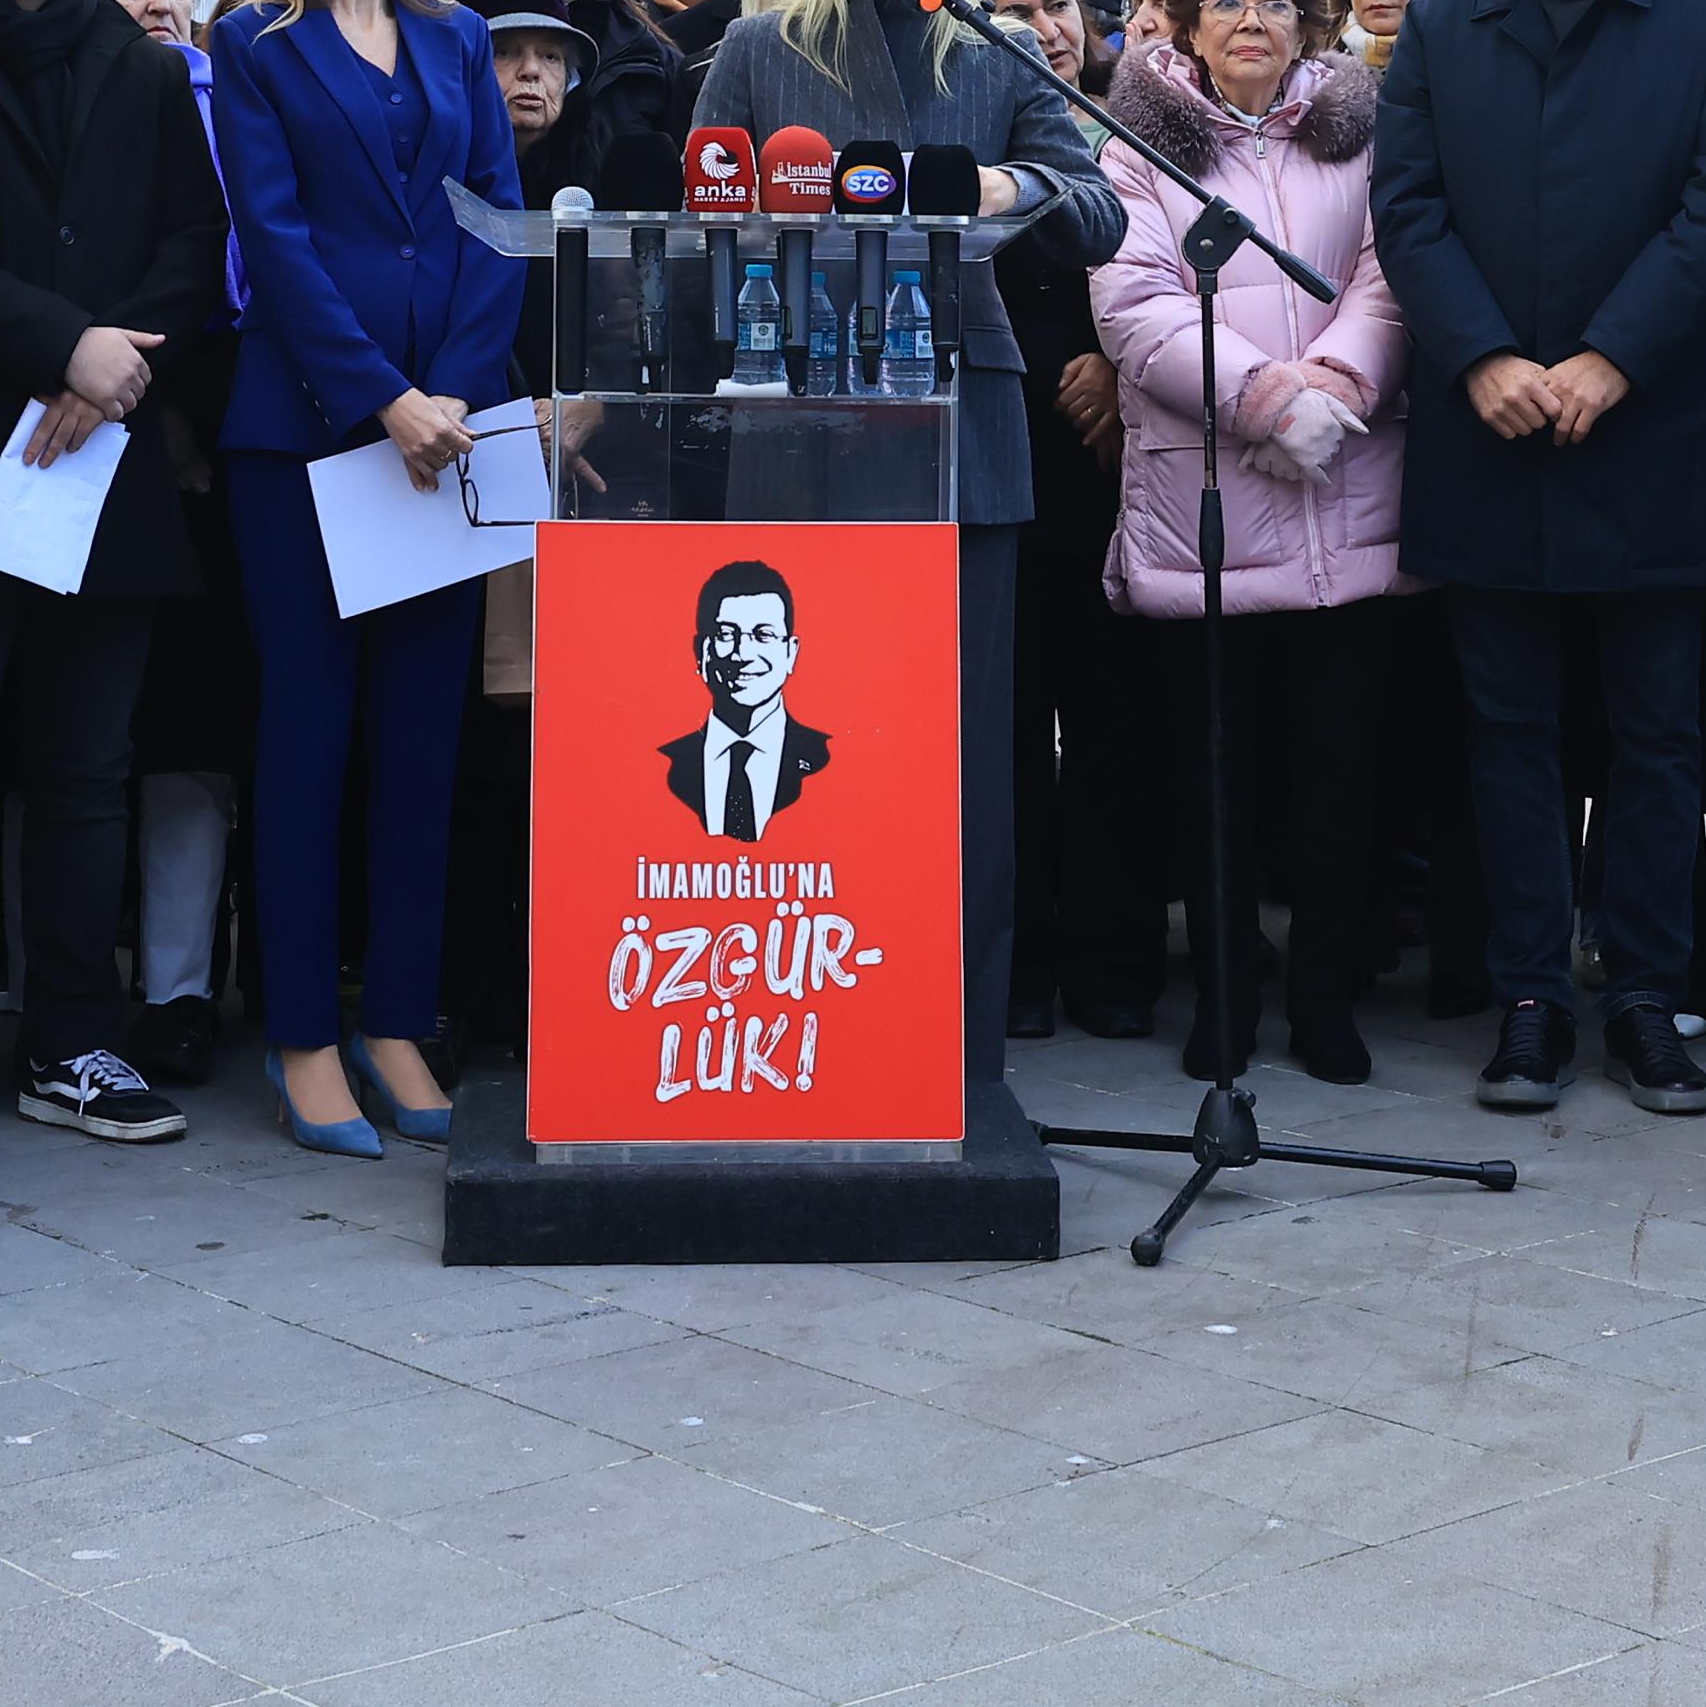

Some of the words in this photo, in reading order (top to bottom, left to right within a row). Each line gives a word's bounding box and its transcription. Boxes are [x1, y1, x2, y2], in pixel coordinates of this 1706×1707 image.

[694, 180, 746, 196] anka
[789, 182, 831, 196] Times
[848, 175, 890, 192] SZC
[637, 855, 834, 899] İMAMOĞLU'NA
[609, 900, 883, 1011] ÖZGÜR-
[655, 1001, 818, 1103] LÜK!
